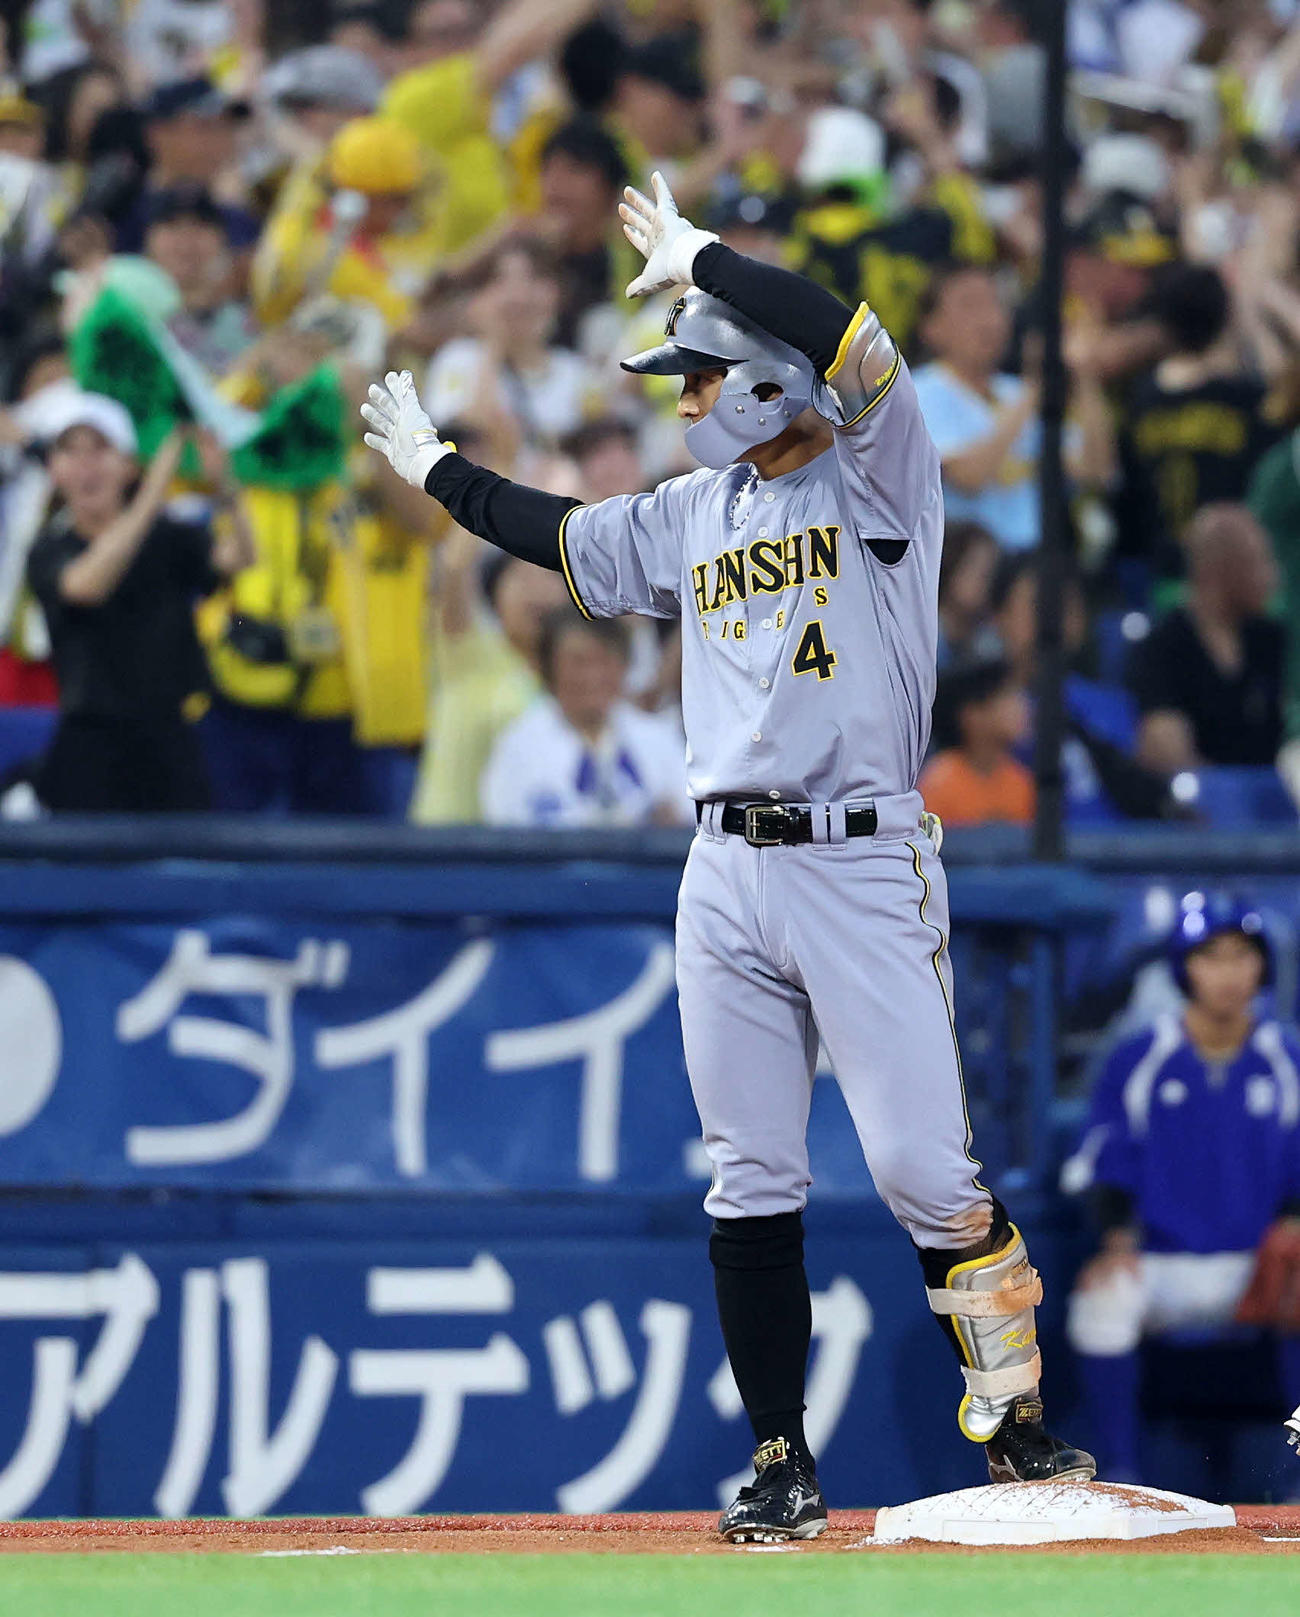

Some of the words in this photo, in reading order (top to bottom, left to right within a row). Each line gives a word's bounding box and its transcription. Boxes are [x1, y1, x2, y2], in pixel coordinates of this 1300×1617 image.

[692, 525, 841, 617] HANSHN
[702, 587, 829, 641] IGES
[791, 619, 838, 681] 4
[116, 929, 835, 1181] ダイイ
